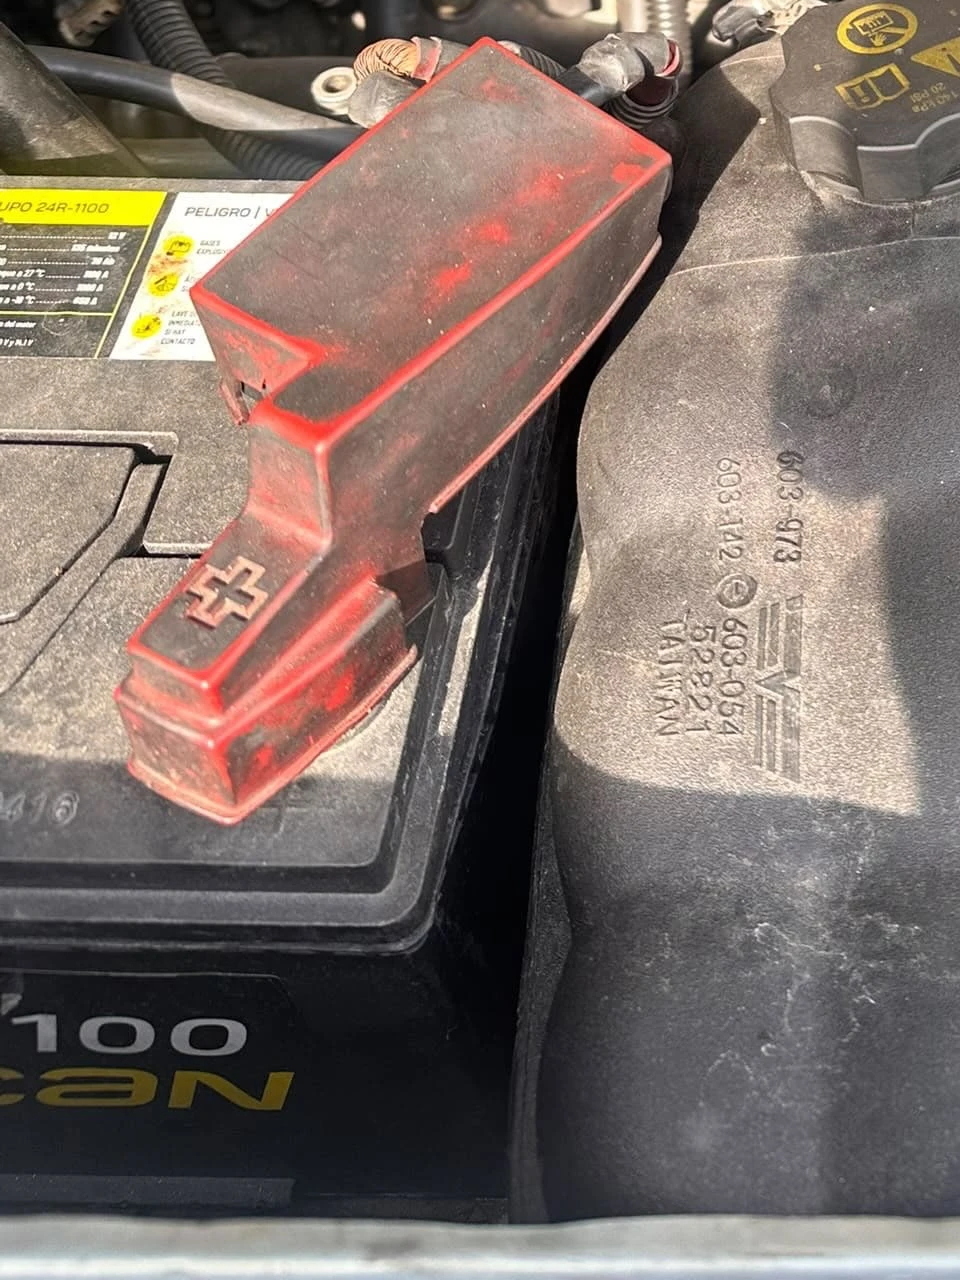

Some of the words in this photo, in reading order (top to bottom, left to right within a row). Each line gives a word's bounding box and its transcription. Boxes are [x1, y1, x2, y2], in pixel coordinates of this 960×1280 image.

[931, 82, 947, 95] 20
[35, 202, 110, 214] 24R-1100
[184, 206, 252, 218] PELIGRO
[160, 337, 196, 345] CONTACTO
[715, 456, 743, 562] 603-142
[772, 449, 805, 565] 603-973
[655, 616, 690, 738] TAIWAN
[685, 623, 718, 734] 52821
[717, 616, 749, 737] 603-054
[10, 1013, 249, 1057] 100
